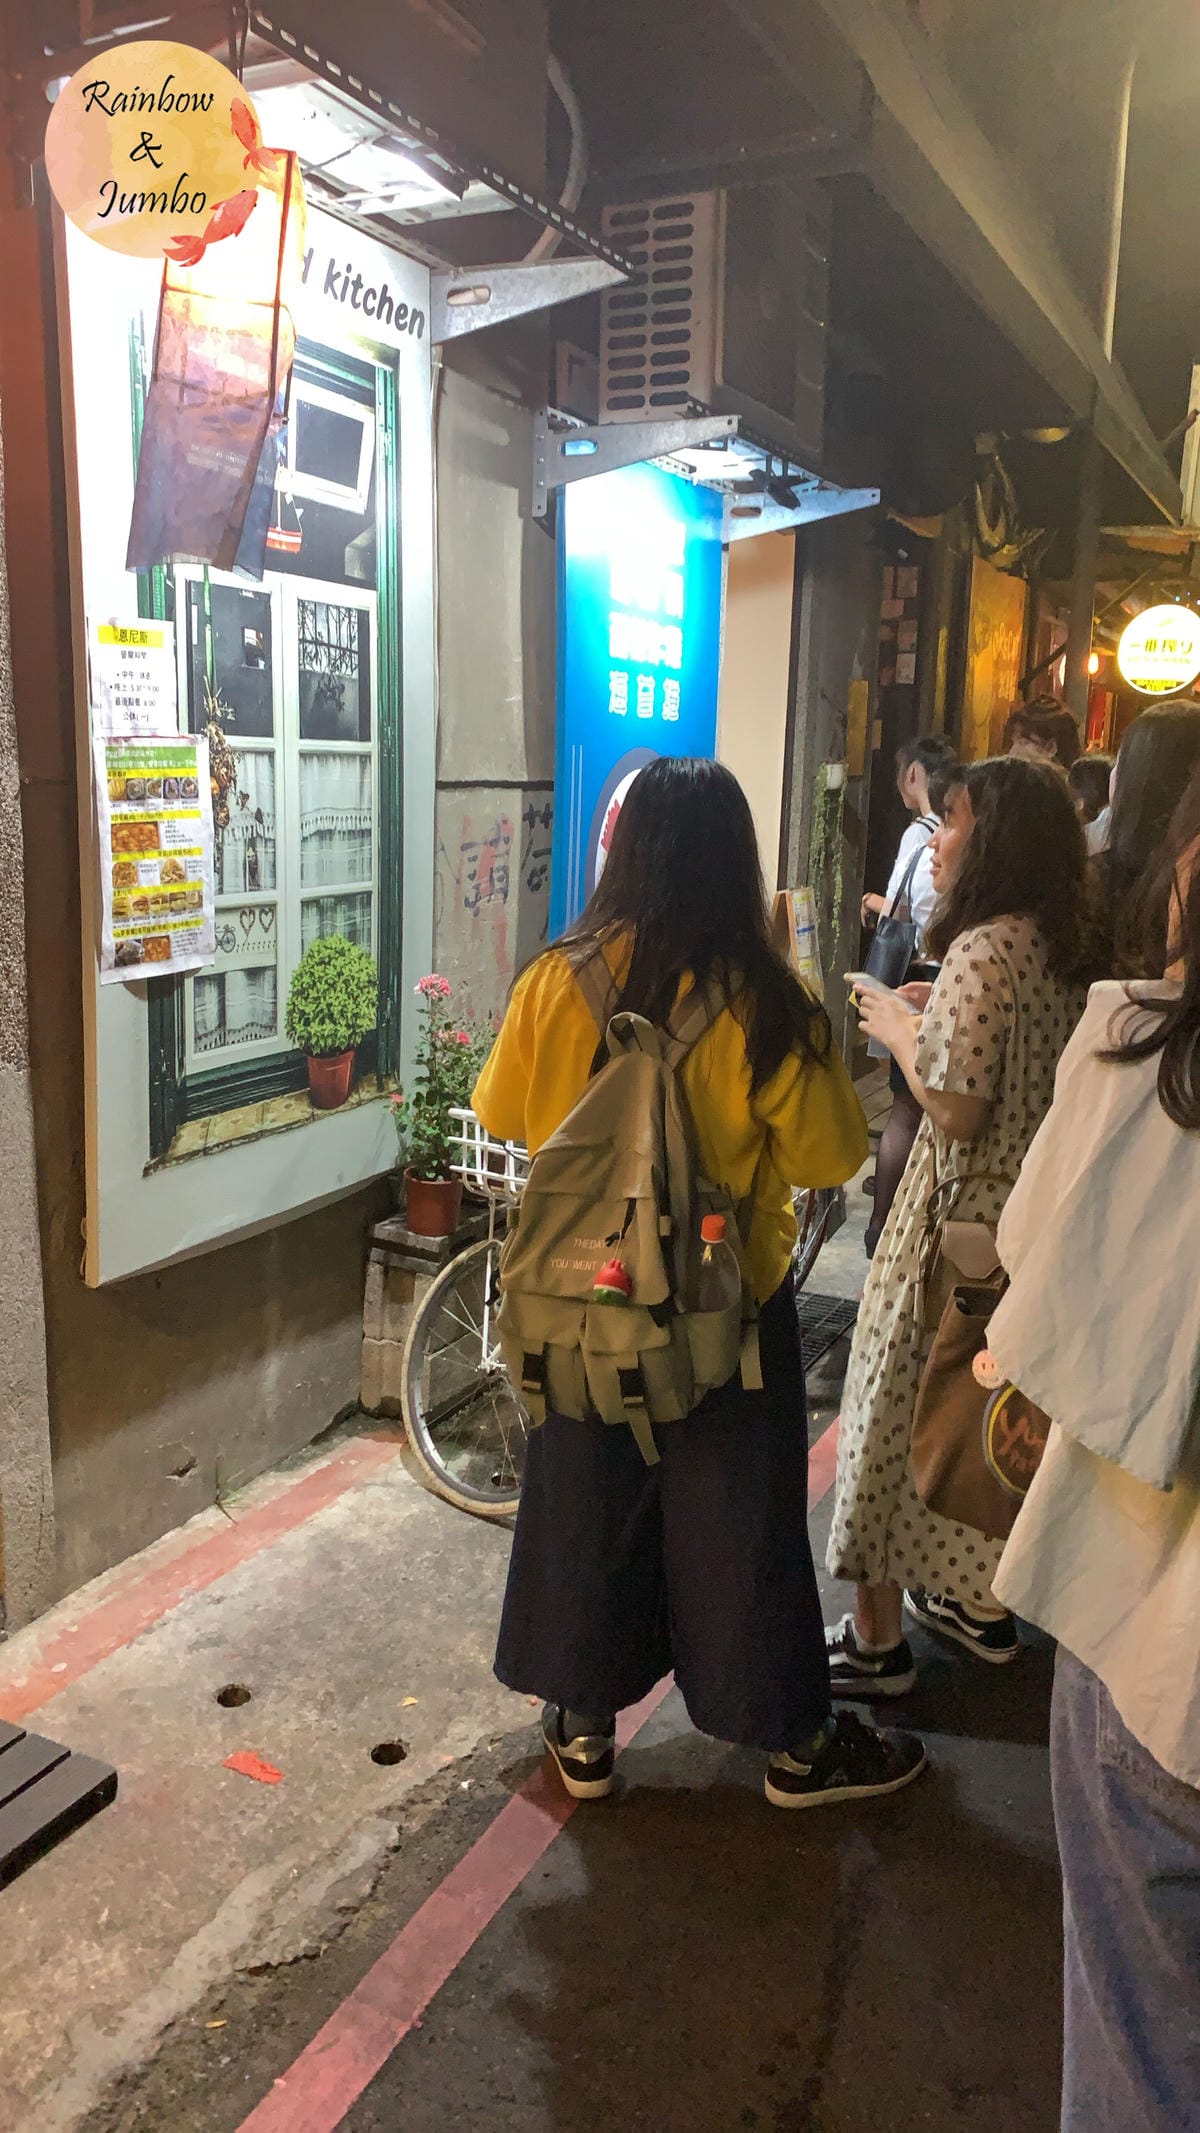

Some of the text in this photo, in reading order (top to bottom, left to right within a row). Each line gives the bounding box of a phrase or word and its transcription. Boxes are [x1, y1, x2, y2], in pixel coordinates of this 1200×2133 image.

[324, 258, 425, 340] kitchen
[551, 1257, 569, 1269] YOU
[573, 1259, 598, 1271] WENT
